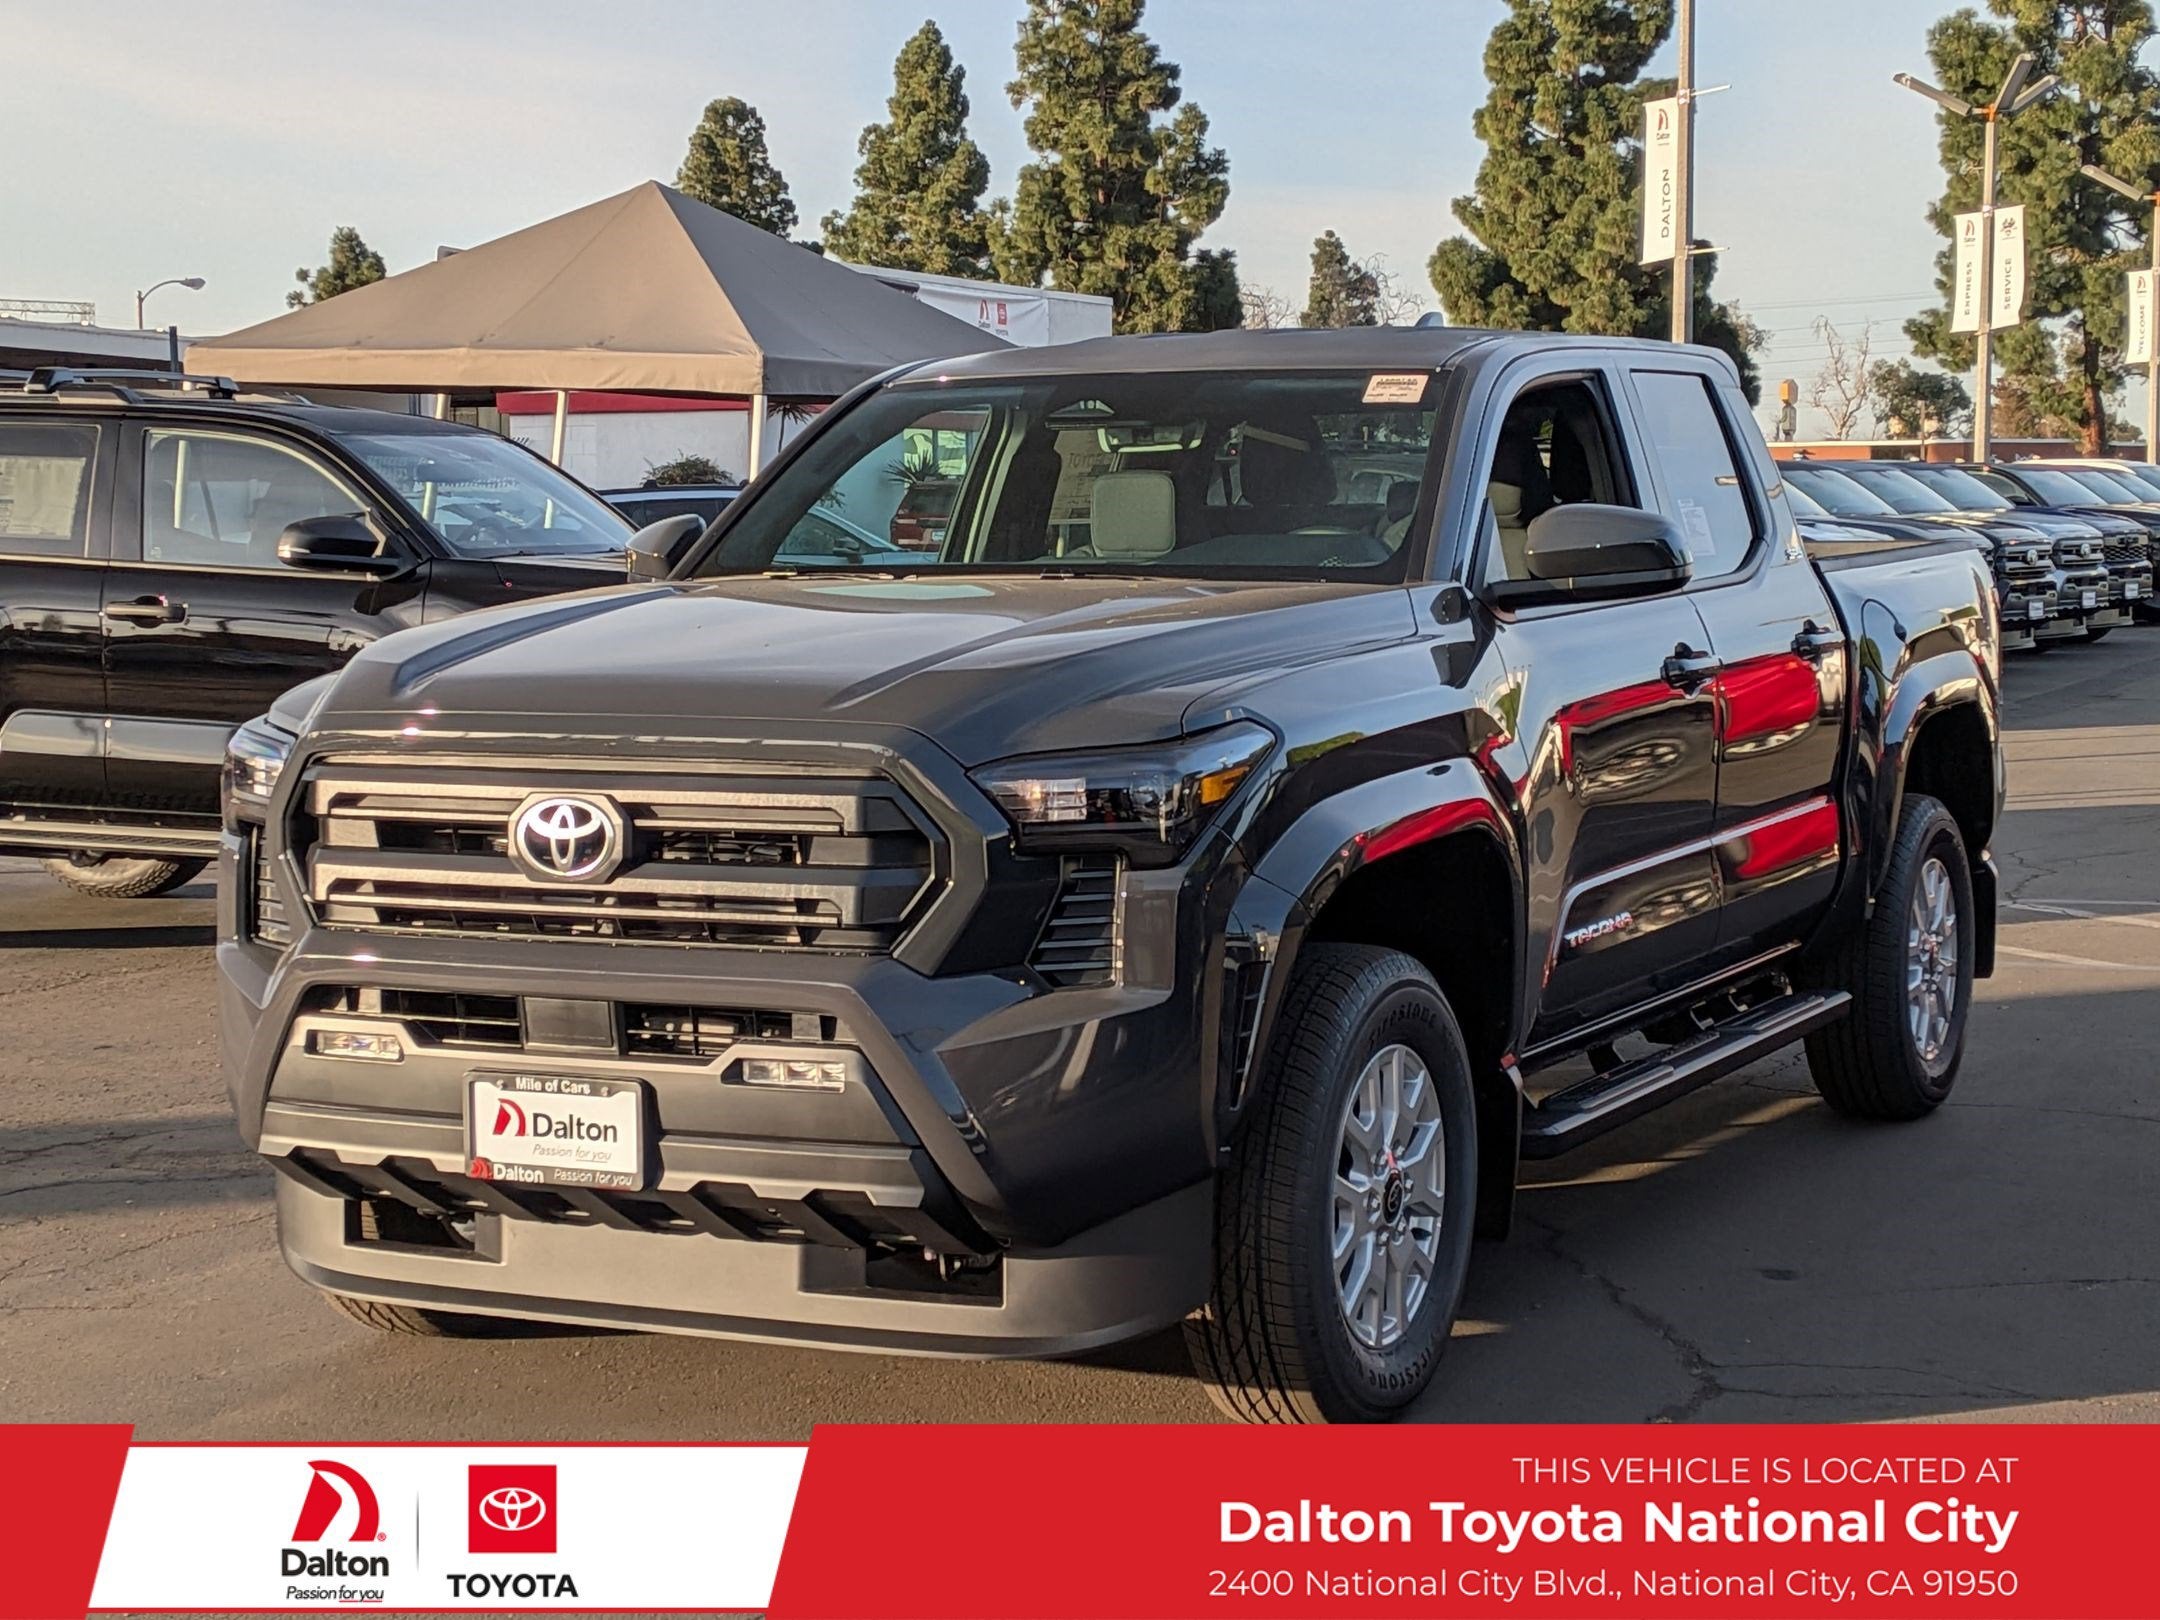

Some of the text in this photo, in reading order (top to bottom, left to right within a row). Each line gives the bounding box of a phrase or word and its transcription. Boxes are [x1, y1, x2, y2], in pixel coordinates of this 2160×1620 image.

[1661, 169, 1672, 238] DALTON
[1964, 261, 1973, 316] EXPRESS
[2004, 258, 2013, 310] SERVICE
[2137, 304, 2146, 356] WELCOME
[1563, 911, 1634, 948] TACOMA
[515, 1076, 591, 1095] Mile of Cars
[532, 1112, 618, 1143] Dalton
[532, 1143, 613, 1162] Passion for you
[493, 1164, 633, 1187] Dalton Passion for you
